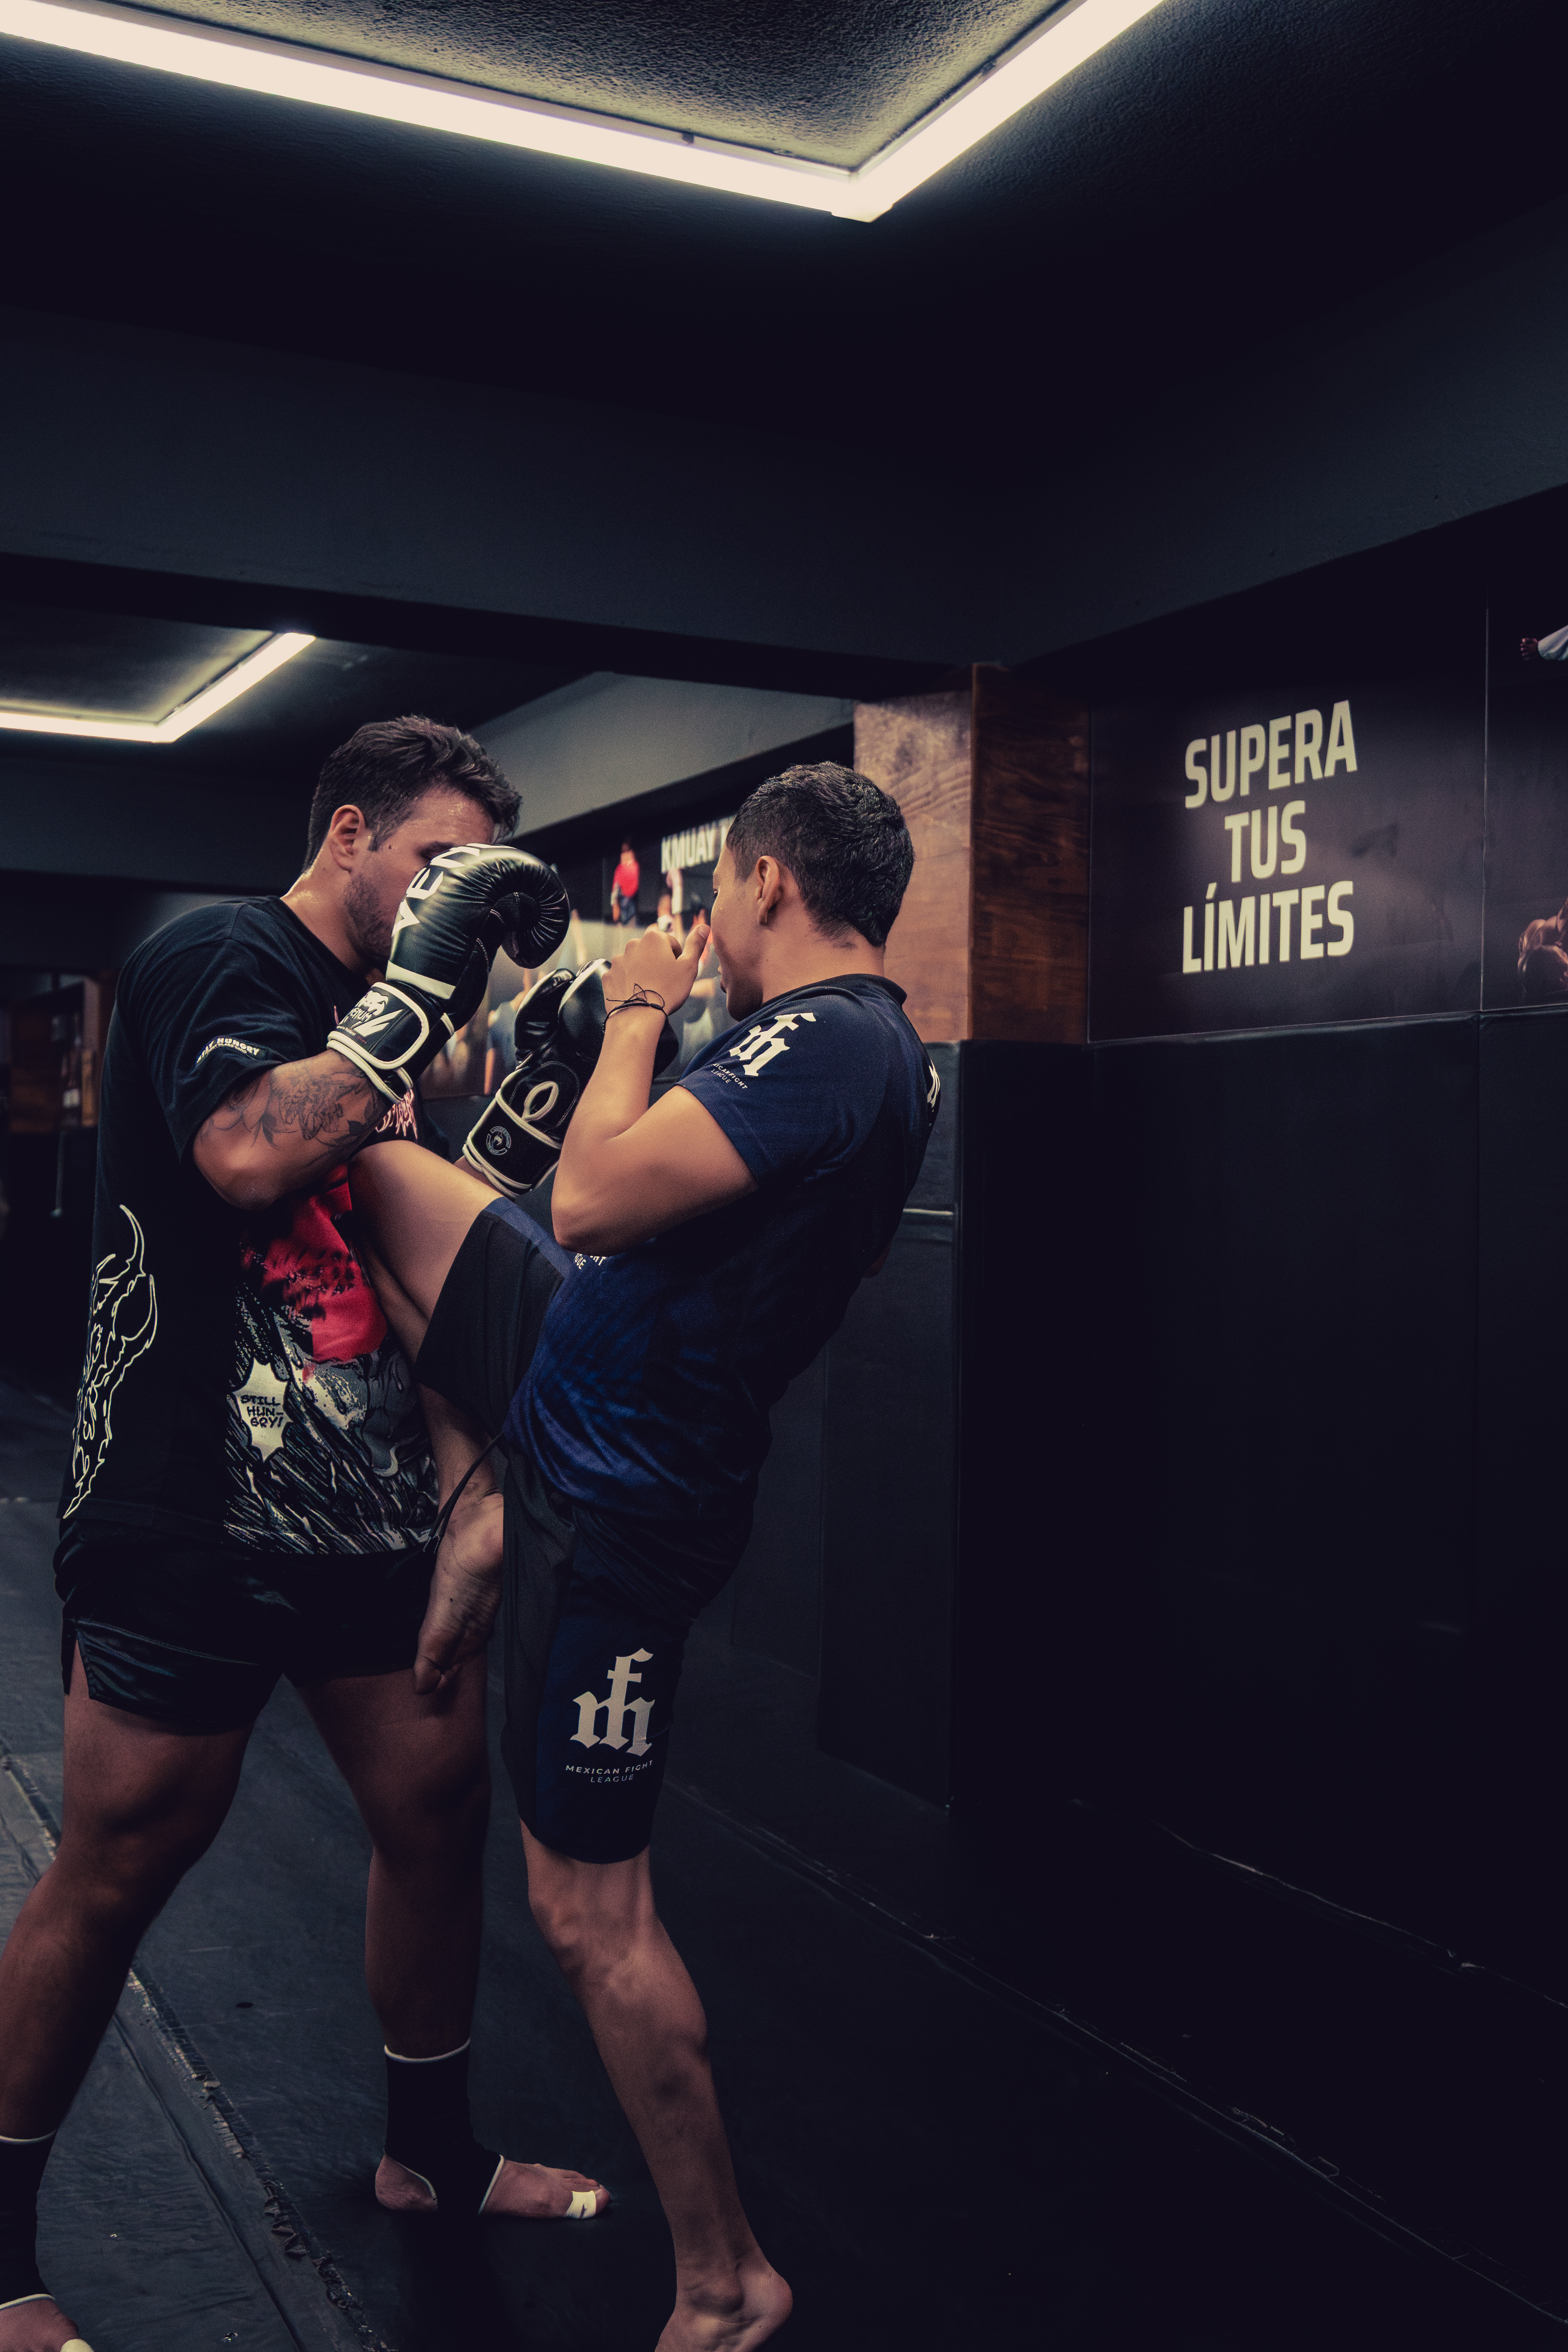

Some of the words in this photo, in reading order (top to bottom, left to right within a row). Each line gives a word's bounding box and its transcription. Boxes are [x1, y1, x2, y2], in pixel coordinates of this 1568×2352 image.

[1185, 700, 1358, 809] SUPERA
[1224, 800, 1307, 883] TUS
[1182, 880, 1354, 974] LÍMITES
[216, 1038, 260, 1056] HUNGRY
[728, 1073, 748, 1089] FIGHT
[240, 1394, 281, 1406] STILL
[565, 1765, 620, 1774] MEXICAN
[625, 1760, 653, 1773] FIGHT
[591, 1774, 634, 1783] LEAGUE
